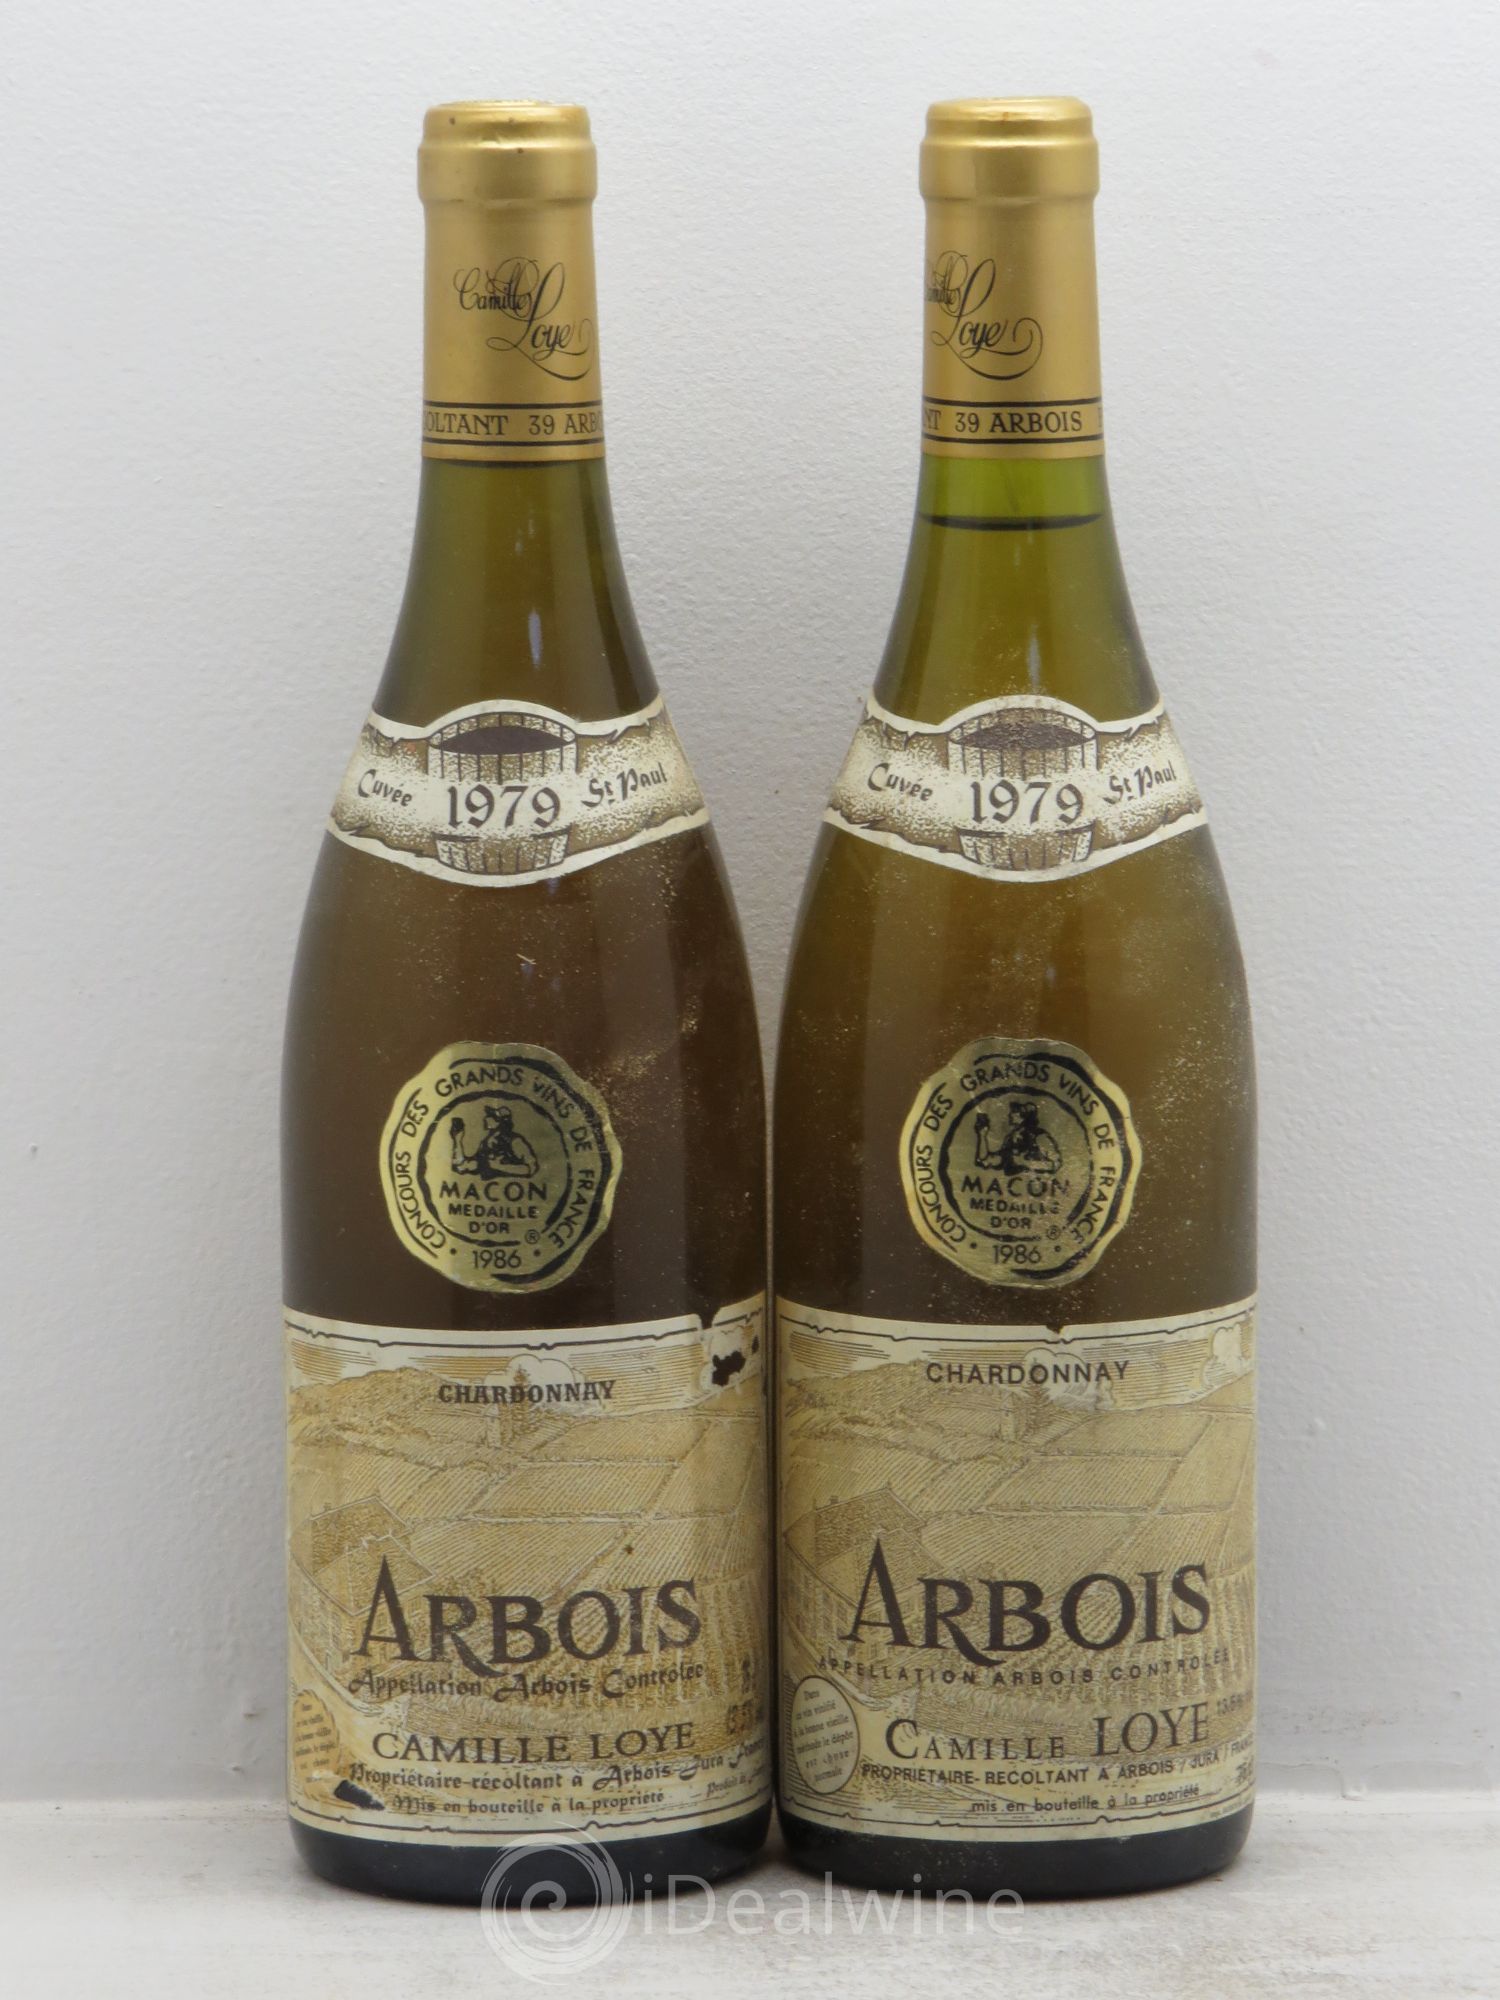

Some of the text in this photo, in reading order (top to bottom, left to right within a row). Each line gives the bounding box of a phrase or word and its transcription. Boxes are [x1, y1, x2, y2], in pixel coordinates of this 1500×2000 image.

[486, 262, 592, 381] Loye
[931, 258, 1043, 381] Loye
[528, 414, 556, 436] 39
[955, 411, 980, 433] 39
[989, 410, 1083, 434] ARBOIS
[447, 785, 561, 830] 1979
[618, 762, 668, 801] Paul
[970, 780, 1085, 825] 1979
[1133, 759, 1178, 799] Paul
[395, 1066, 595, 1250] CONCOURS DES GRANDS VINS DE FRANCE
[916, 1062, 1117, 1245] CONCOURS DES GRANDS VINS DE FRANCE
[439, 1180, 548, 1202] MACON
[961, 1175, 1071, 1197] MACON
[448, 1203, 539, 1219] MEDAILLE
[970, 1197, 1060, 1213] MEDAILLE
[469, 1221, 510, 1235] D'OR
[990, 1216, 1031, 1230] D'OR
[472, 1249, 522, 1270] 1986
[991, 1244, 1042, 1265] 1986
[926, 1360, 1130, 1385] CHARDONNAY
[438, 1380, 616, 1404] CHARDONNAY
[838, 1537, 1211, 1667] ARBOIS
[350, 1553, 702, 1679] ARBOIS
[815, 1658, 975, 1685] APPELLATION
[993, 1669, 1093, 1687] ARBOIS
[348, 1667, 482, 1699] Appellation
[493, 1671, 592, 1703] Arbois
[372, 1732, 571, 1764] CAMILLE
[589, 1721, 696, 1760] LOYE
[886, 1701, 1209, 1760] CAMILLE LOYE
[572, 1769, 583, 1787] à
[985, 1767, 1089, 1785] RECOLTANT
[1098, 1767, 1110, 1781] A
[1118, 1759, 1174, 1779] ARBOIS
[1190, 1749, 1219, 1769] JURA
[443, 1803, 461, 1813] en
[469, 1799, 544, 1814] bouteille
[552, 1798, 561, 1813] à
[570, 1797, 585, 1811] la
[971, 1801, 997, 1813] mis
[1034, 1795, 1099, 1811] bouteille
[1107, 1795, 1116, 1808] à
[1125, 1793, 1137, 1806] la
